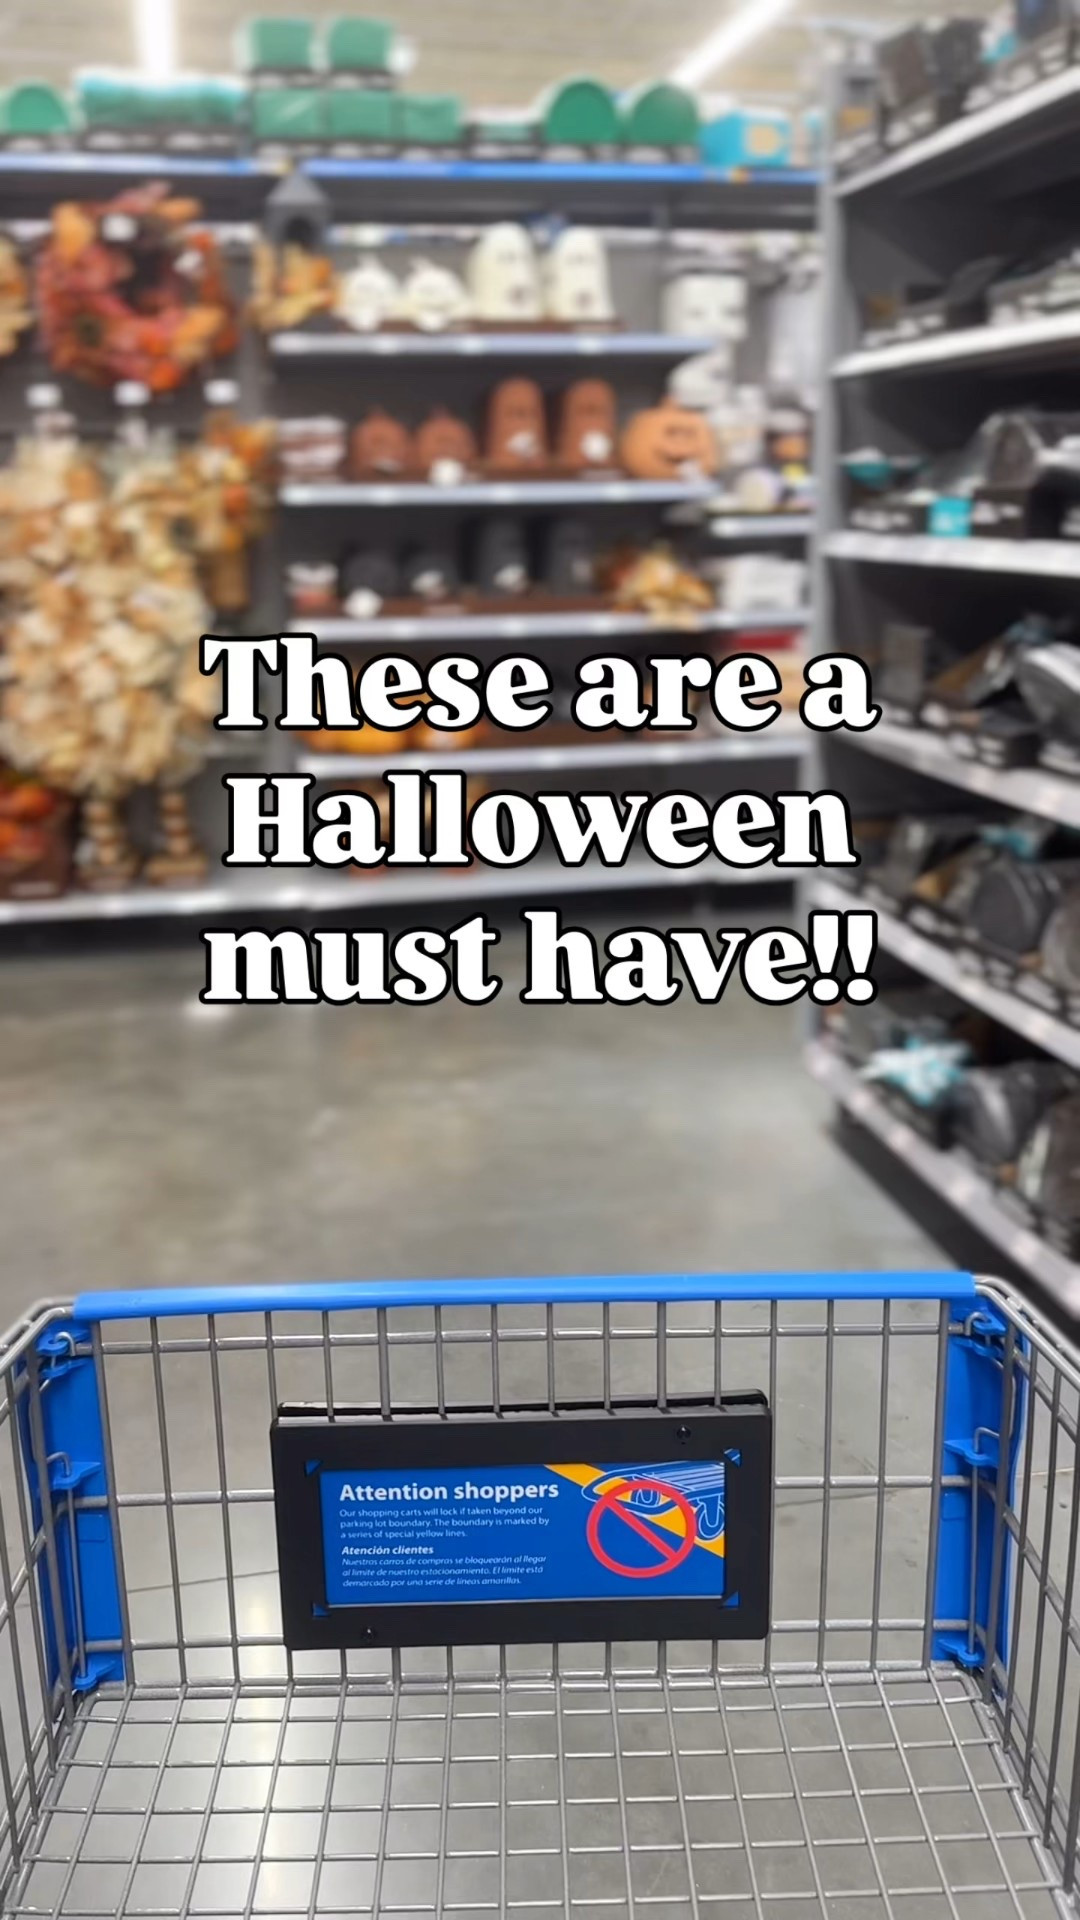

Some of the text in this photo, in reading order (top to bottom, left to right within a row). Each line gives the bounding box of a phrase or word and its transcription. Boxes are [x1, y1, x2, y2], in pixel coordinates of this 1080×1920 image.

[339, 1481, 559, 1503] Attention shoppers
[339, 1506, 544, 1519] Our shopping carts will lock if taken beyond our
[340, 1516, 550, 1529] parking lot boundary. The boundary is marked by
[340, 1528, 468, 1540] a series of special yellow lines.
[341, 1544, 435, 1556] Atención clientes
[341, 1554, 547, 1568] Nuestros carros de compras se bloquearán al llegar
[341, 1568, 351, 1577] al
[376, 1567, 387, 1577] de
[388, 1568, 420, 1577] nuestro
[420, 1566, 491, 1576] estacionamiento.
[492, 1565, 501, 1576] El
[342, 1578, 390, 1588] demarcado
[390, 1579, 406, 1589] por
[407, 1579, 424, 1587] una
[424, 1578, 444, 1587] serie
[444, 1577, 456, 1587] de
[481, 1575, 522, 1586] amarillas.
